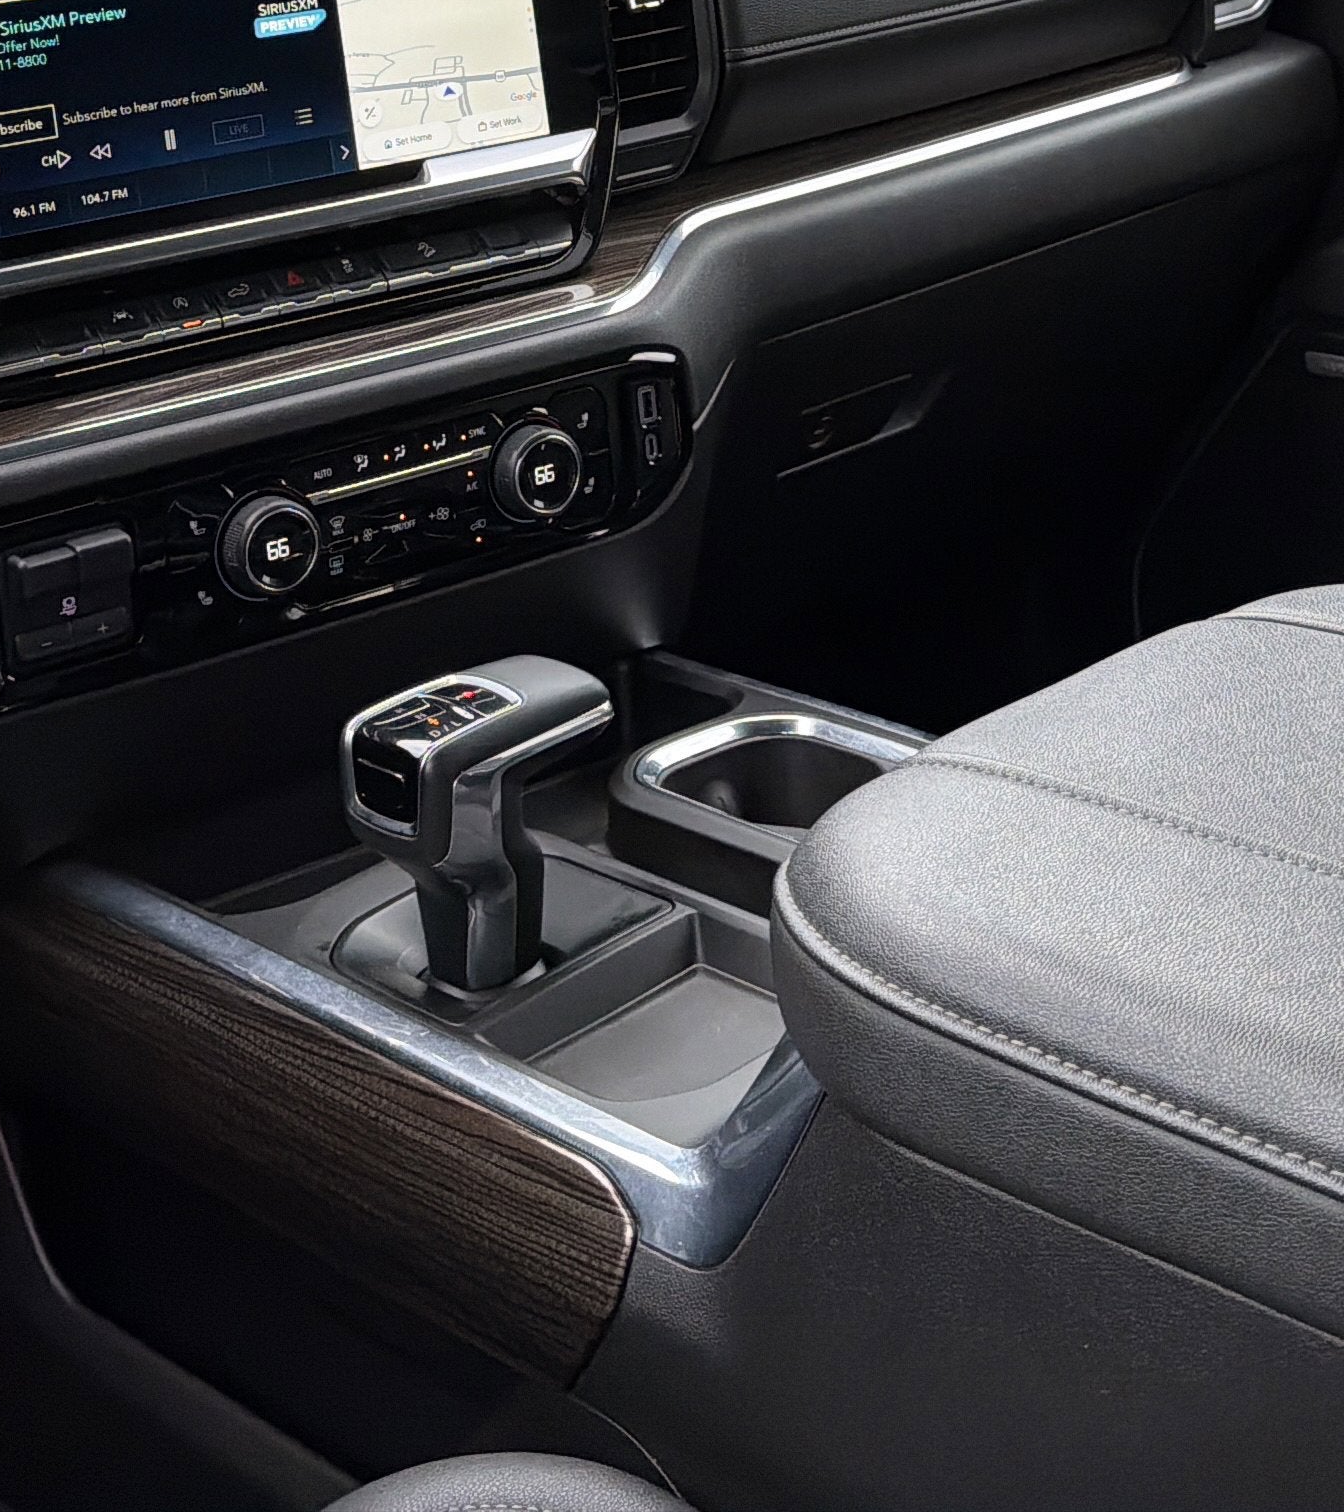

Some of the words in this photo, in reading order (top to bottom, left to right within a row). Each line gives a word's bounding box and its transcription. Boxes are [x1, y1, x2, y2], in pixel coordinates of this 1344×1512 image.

[0, 14, 66, 37] SiriusXM
[69, 7, 127, 28] Preview
[31, 35, 60, 50] Now!
[63, 105, 117, 126] Subscribe
[120, 104, 132, 115] to
[134, 100, 158, 114] hear
[161, 96, 189, 109] more
[191, 90, 217, 104] from
[219, 81, 268, 100] SiriusXM.
[510, 90, 539, 103] Google
[229, 122, 251, 135] LIVE
[489, 119, 504, 129] Set
[504, 116, 522, 128] Work
[395, 136, 409, 147] Set
[410, 133, 433, 145] Home
[41, 155, 57, 167] CH
[81, 192, 110, 206] 104.7
[112, 188, 129, 200] FM
[13, 205, 36, 219] 96.1
[39, 201, 56, 214] FM
[468, 425, 487, 439] SYNC
[313, 468, 333, 480] AUTO
[535, 463, 556, 486] 66
[465, 481, 479, 493] A/C
[391, 518, 417, 534] ON/OFF
[266, 538, 290, 561] 66
